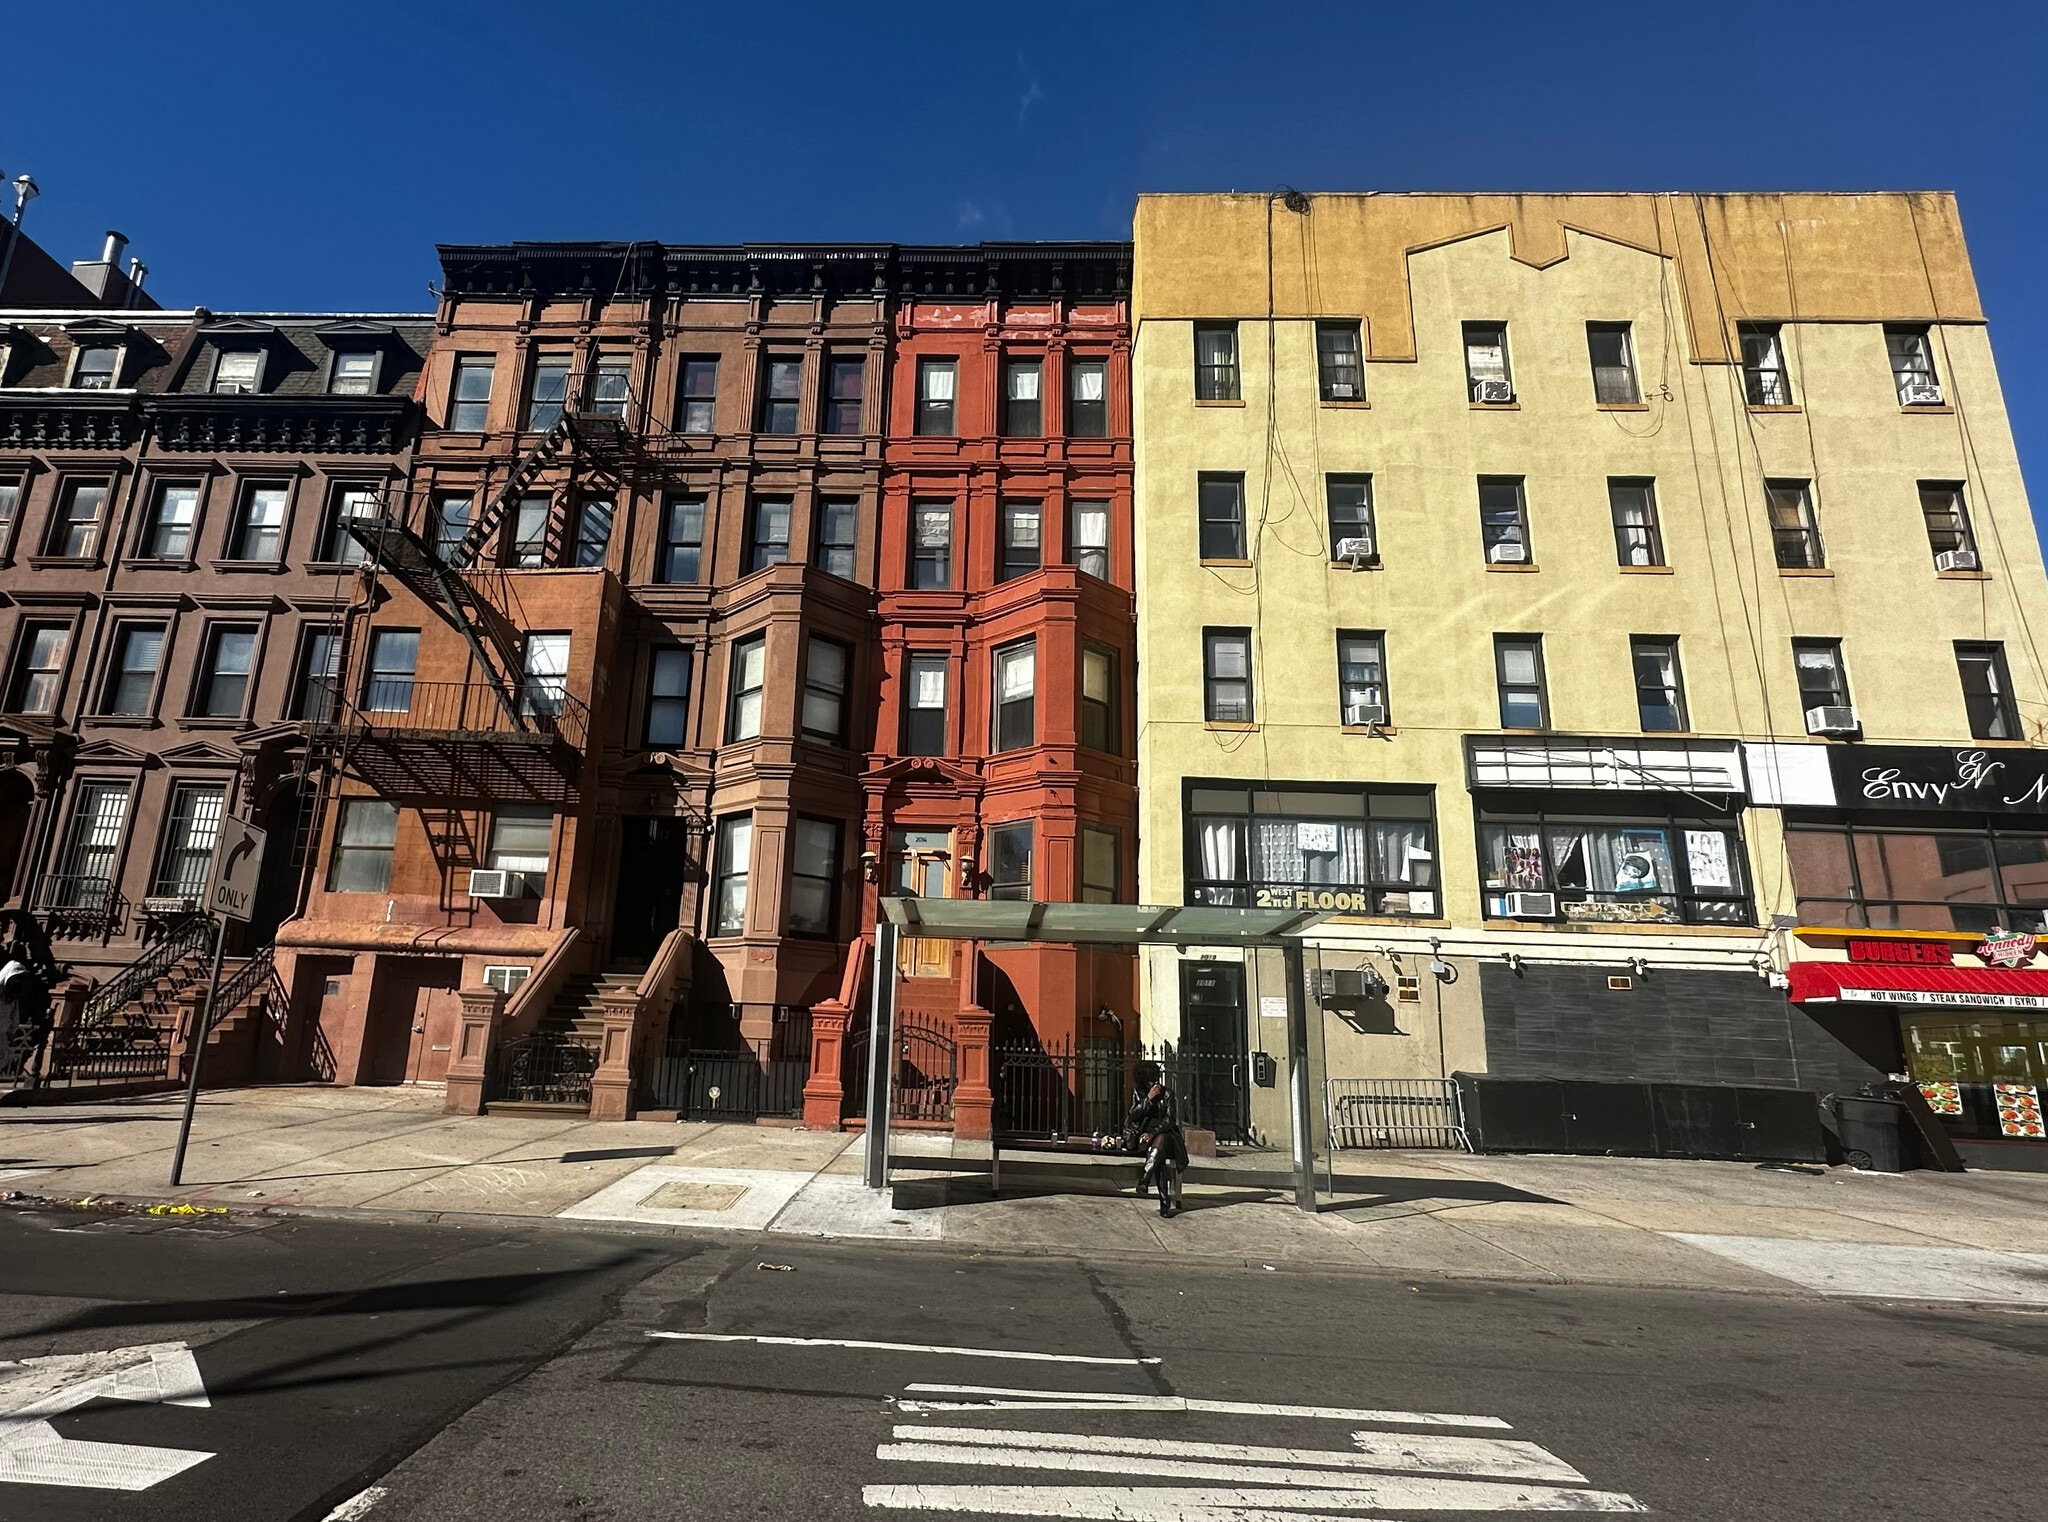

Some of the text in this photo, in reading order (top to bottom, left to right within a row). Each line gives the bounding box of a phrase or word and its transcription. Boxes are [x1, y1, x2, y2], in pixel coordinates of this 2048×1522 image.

[1862, 768, 1948, 804] Envy
[218, 886, 248, 910] ONLY
[1256, 889, 1366, 910] 2nd FLOOR
[1850, 941, 1951, 964] BURGERS
[1977, 934, 2035, 956] Kennedy
[1870, 992, 1886, 1001] HOT
[1888, 992, 1918, 1002] WINGS
[1930, 993, 1957, 1003] STEAK
[1959, 994, 2005, 1005] SANDWICH
[2014, 996, 2038, 1006] GYRO
